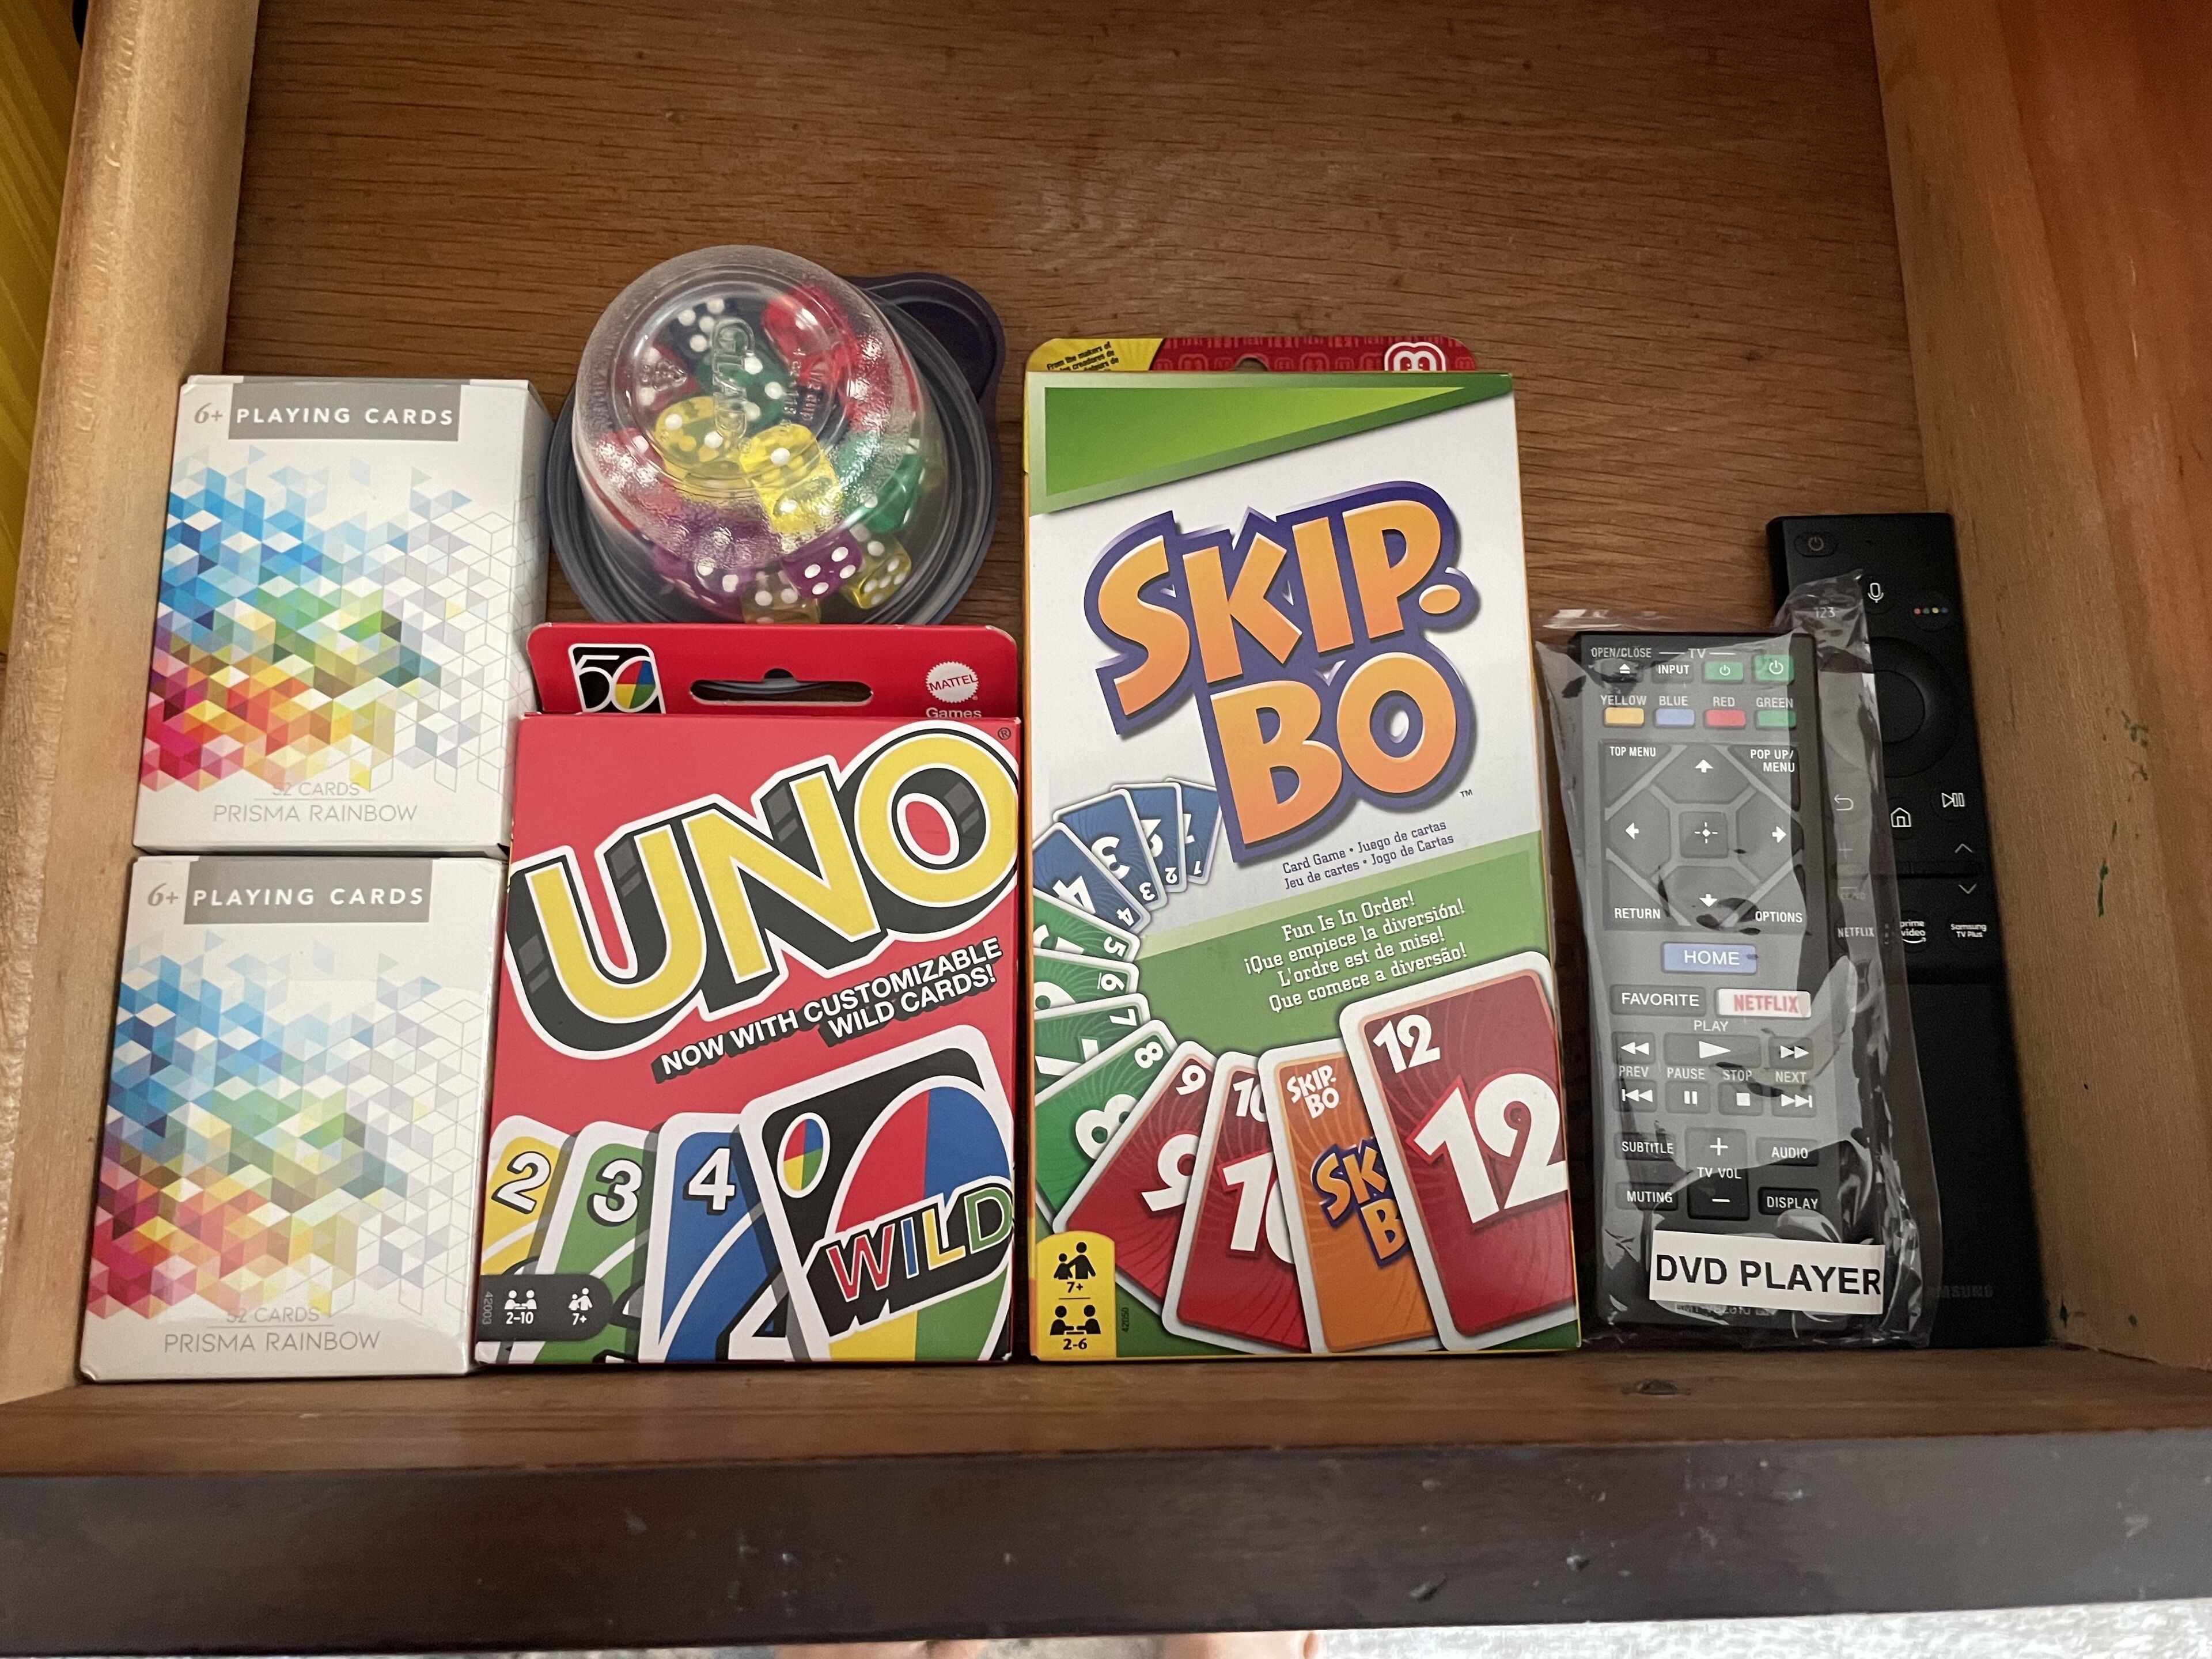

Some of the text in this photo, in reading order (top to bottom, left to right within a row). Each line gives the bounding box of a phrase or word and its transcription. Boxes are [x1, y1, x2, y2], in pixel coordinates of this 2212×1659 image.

[193, 403, 453, 426] 6+ PLAYING CARDS
[1813, 605, 1836, 619] 123
[1590, 647, 1707, 659] OPEN/CLOSE TV
[1657, 664, 1690, 676] INPUT
[929, 674, 979, 692] MATTEL
[1600, 695, 1794, 709] YELLOW BLUE RED GREEN
[926, 706, 982, 718] Games
[1609, 746, 1794, 761] TOP MENU POP UP/
[1762, 761, 1796, 773] MENU
[298, 782, 360, 796] CARDS
[213, 804, 418, 823] PRISMA RAINBOW
[1282, 820, 1446, 874] Card Game Juego de cartas
[1284, 834, 1455, 890] Jeu de cartes Jogo de Cartas
[1164, 866, 1178, 884] 2
[147, 882, 424, 907] 6+ PLAYING CARDS
[510, 722, 1019, 1054] UNO
[1138, 881, 1156, 902] 3
[1116, 907, 1135, 927] 4
[1281, 890, 1415, 942] Fun Is In Order!
[1614, 907, 1804, 924] RETURN OPTIONS
[1899, 919, 1925, 928] prime
[1244, 898, 1465, 975] ¡Que empiece la diversión!
[1837, 926, 1875, 938] NETFLIX
[1900, 928, 1926, 937] video
[1950, 923, 1988, 932] Samsung
[1956, 930, 1967, 938] TV
[1103, 935, 1127, 957] 5
[1277, 925, 1445, 988] L'ordre est de mise!
[1684, 949, 1741, 966] HOME
[1098, 972, 1125, 991] 6
[1268, 941, 1468, 1013] Que comece a diversão!
[660, 1036, 725, 1076] NOW
[729, 1009, 800, 1049] WITH
[803, 937, 1002, 1023] CUSTOMIZABLE
[827, 1001, 895, 1039] WILD
[900, 964, 998, 1014] CARDS!
[1621, 992, 1800, 1014] FAVORITE NETFLIX
[1109, 1008, 1138, 1027] 7
[1693, 1019, 1729, 1032] PLAY
[1372, 1013, 1441, 1074] 12
[1134, 1041, 1164, 1069] 8
[1175, 1065, 1206, 1095] 9
[1618, 1065, 1807, 1084] PREV PAUSE STOP NEXT
[1304, 1088, 1340, 1119] BO
[1411, 1071, 1569, 1225] 12
[1621, 1141, 1809, 1160] SUBTITLE AUDIO
[491, 1150, 551, 1213] 2
[686, 1147, 736, 1215] 4
[1696, 1166, 1743, 1180] TV VOL
[589, 1159, 643, 1227] 3
[1626, 1190, 1819, 1210] MUTING DISPLAY
[821, 1180, 1013, 1308] WILD
[1655, 1253, 1882, 1296] DVD PLAYER
[1066, 1281, 1084, 1294] 7+
[254, 1306, 320, 1323] CARDS
[481, 1290, 494, 1326] 42003
[505, 1310, 535, 1325] 2-10
[571, 1312, 588, 1326] 7+
[164, 1330, 381, 1354] PRISMA RAINBOW
[1062, 1338, 1088, 1350] 2-6
